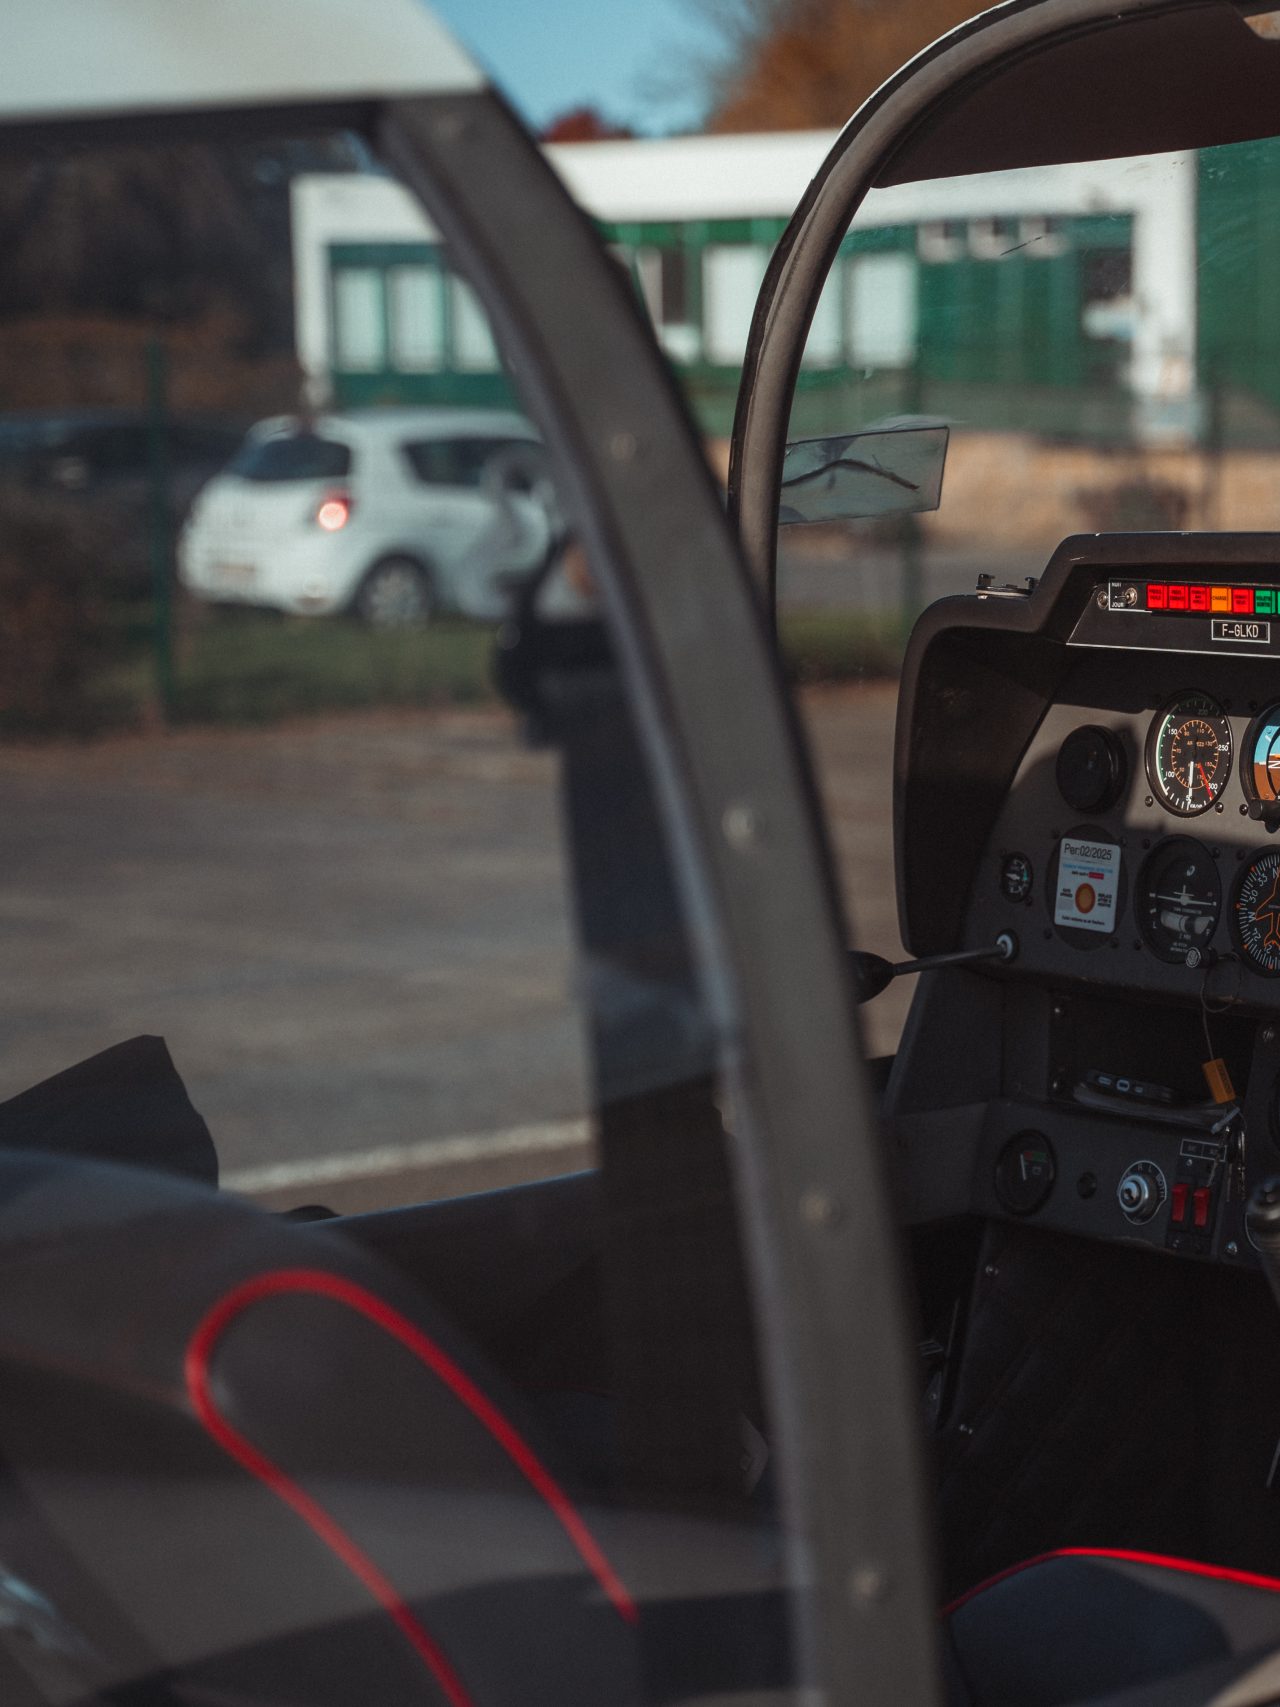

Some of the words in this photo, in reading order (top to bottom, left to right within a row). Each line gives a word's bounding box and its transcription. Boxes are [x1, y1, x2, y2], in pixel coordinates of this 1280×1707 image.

[1222, 624, 1259, 638] F-GLKD
[1217, 743, 1229, 751] 250
[1248, 890, 1259, 903] 30
